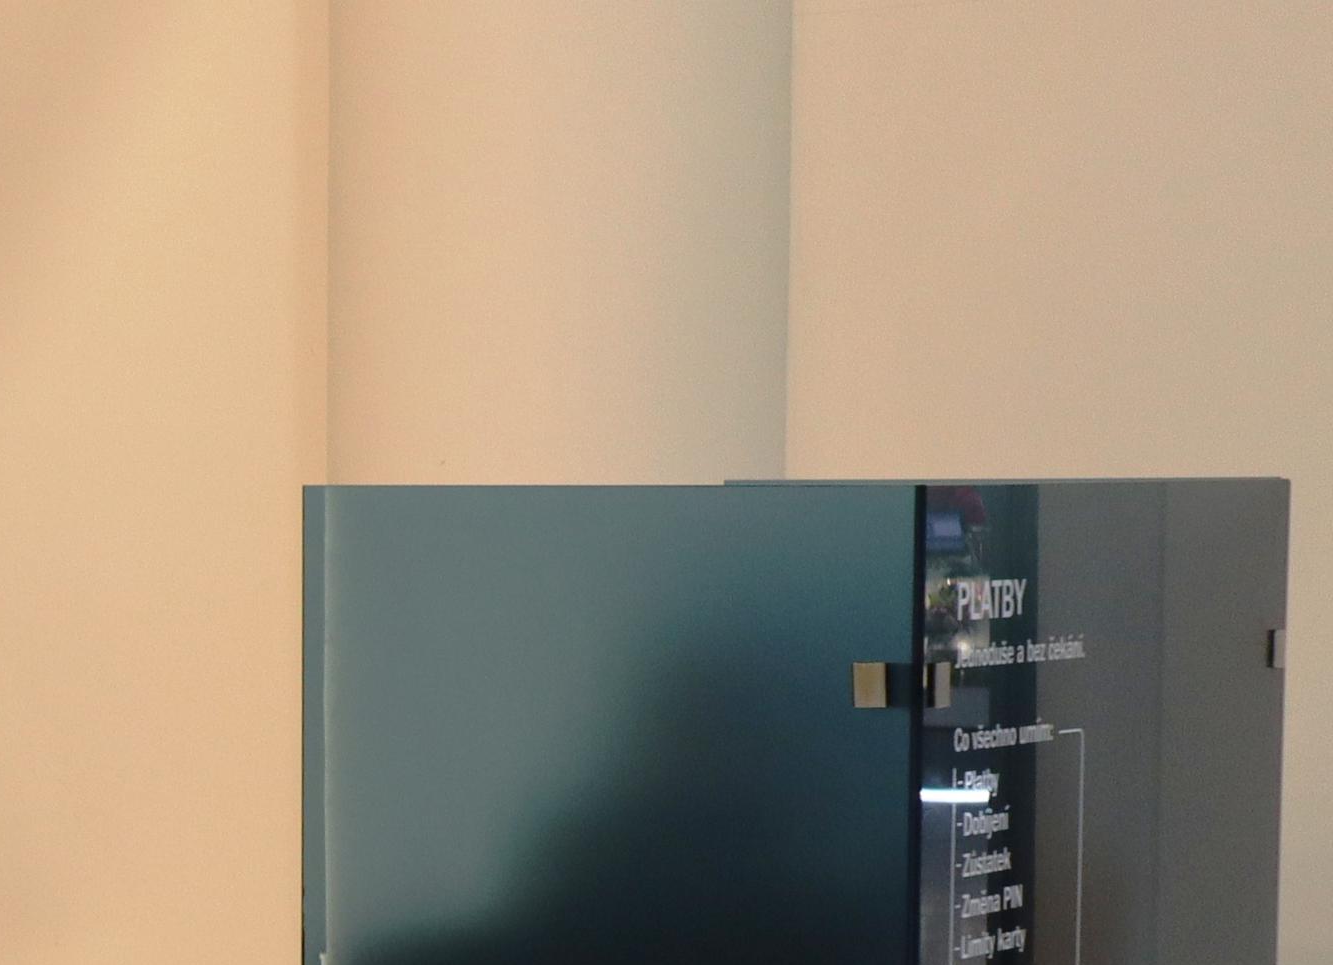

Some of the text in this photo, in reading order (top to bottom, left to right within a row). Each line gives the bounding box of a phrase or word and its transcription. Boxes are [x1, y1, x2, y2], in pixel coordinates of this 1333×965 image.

[957, 578, 1027, 621] PLATBY
[1016, 645, 1025, 664] a
[1026, 638, 1046, 663] bez
[954, 727, 970, 753] Co
[971, 723, 1017, 750] všechno
[964, 768, 1000, 797] Platby
[963, 804, 1010, 840] Dobíjení
[962, 846, 1012, 878] Zůstatek
[961, 889, 1001, 918] Změna
[1003, 883, 1023, 910] PIN
[961, 931, 995, 960] Limity
[997, 925, 1027, 953] karty
